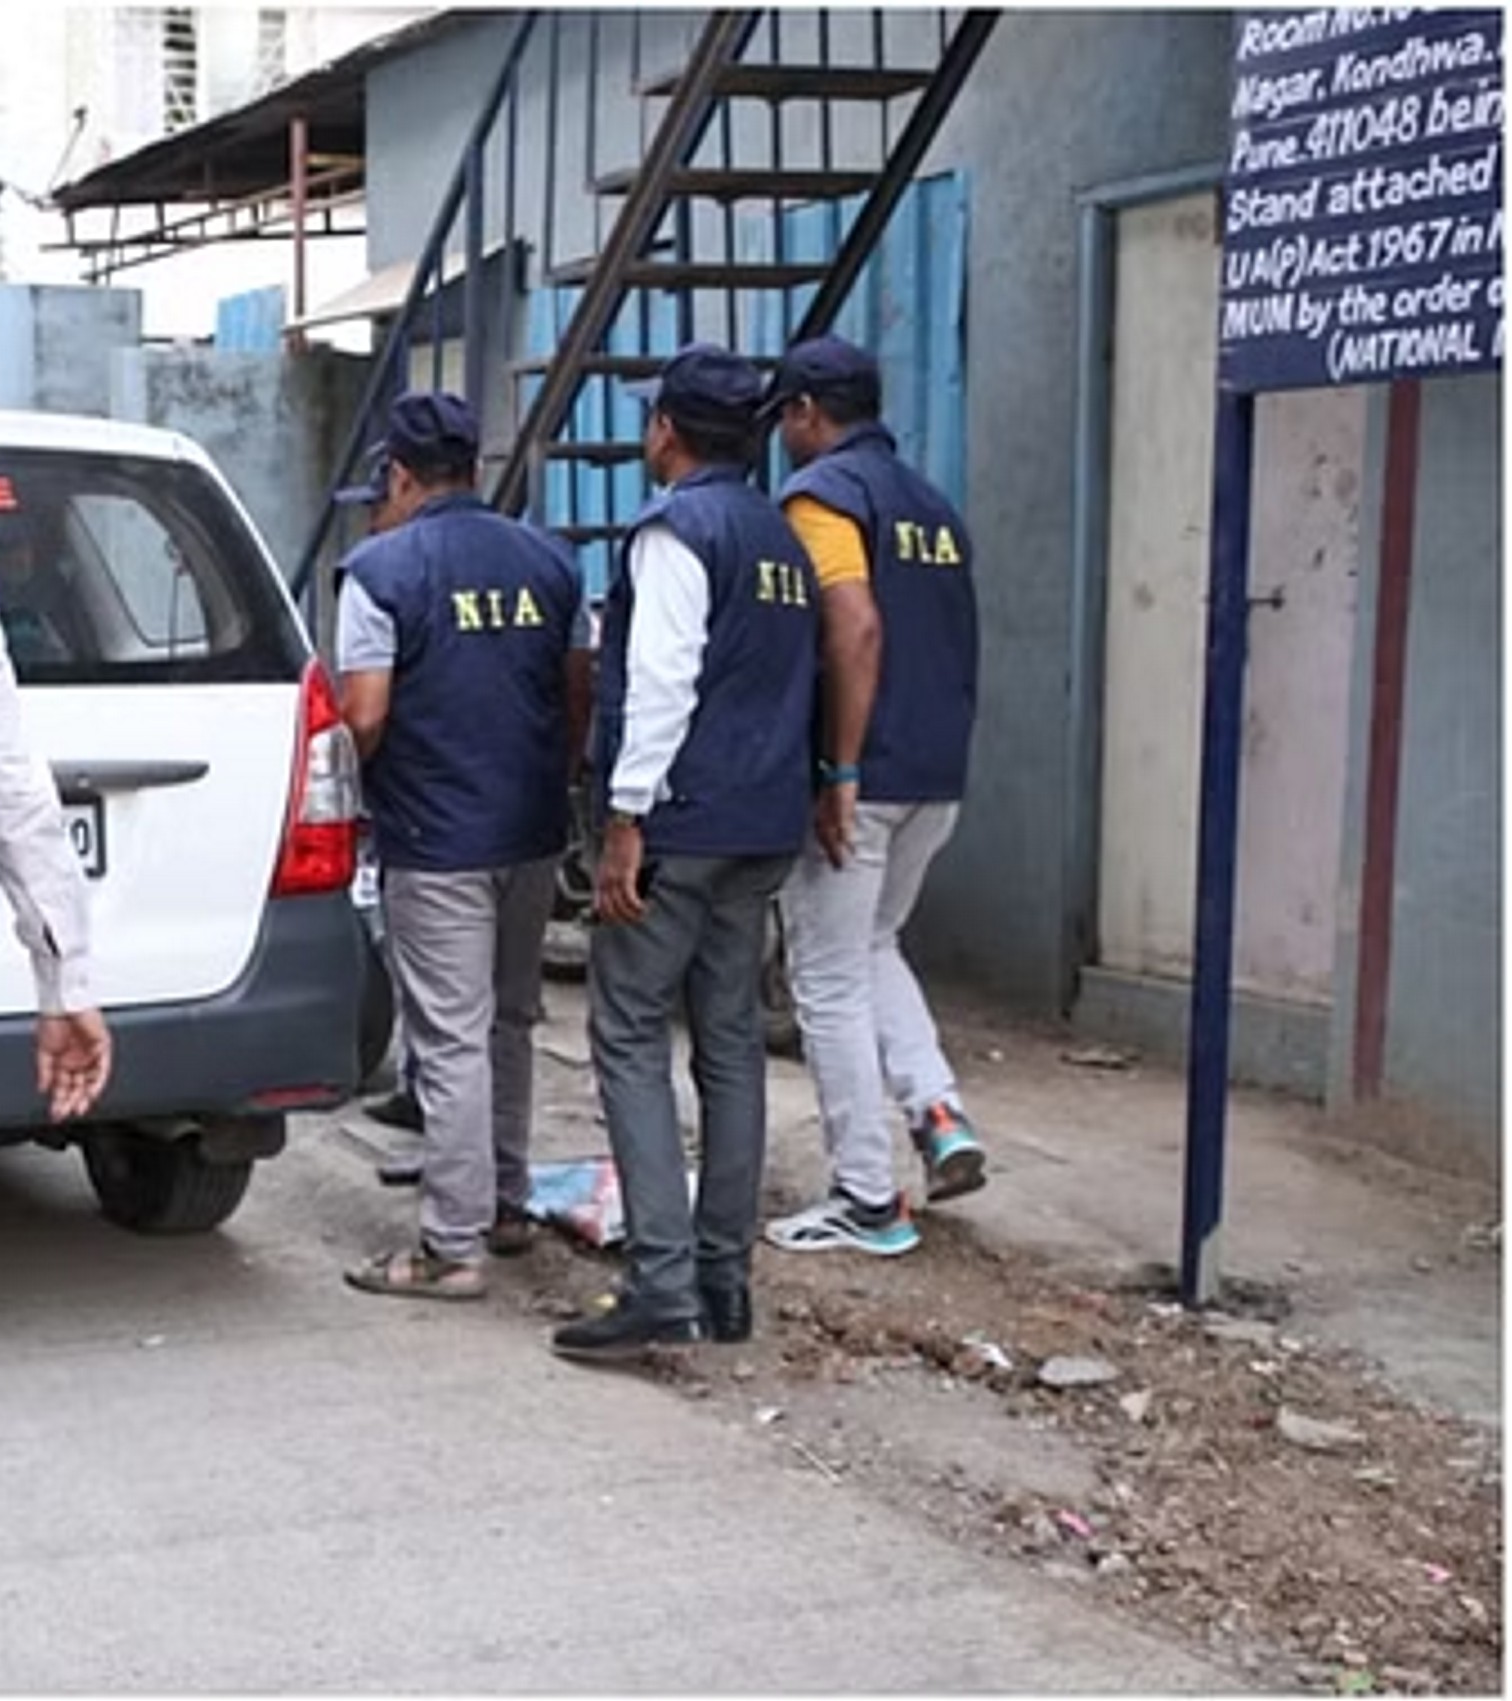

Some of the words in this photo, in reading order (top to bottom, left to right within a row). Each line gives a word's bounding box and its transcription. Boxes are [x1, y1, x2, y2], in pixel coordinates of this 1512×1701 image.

[1236, 10, 1328, 60] Room
[1227, 177, 1320, 234] Stand
[1326, 144, 1498, 215] attached
[1366, 216, 1453, 270] 1967
[1295, 290, 1333, 339] by
[1338, 284, 1386, 325] the
[1392, 272, 1480, 317] order
[894, 520, 960, 564] NIA
[450, 588, 543, 632] NIA
